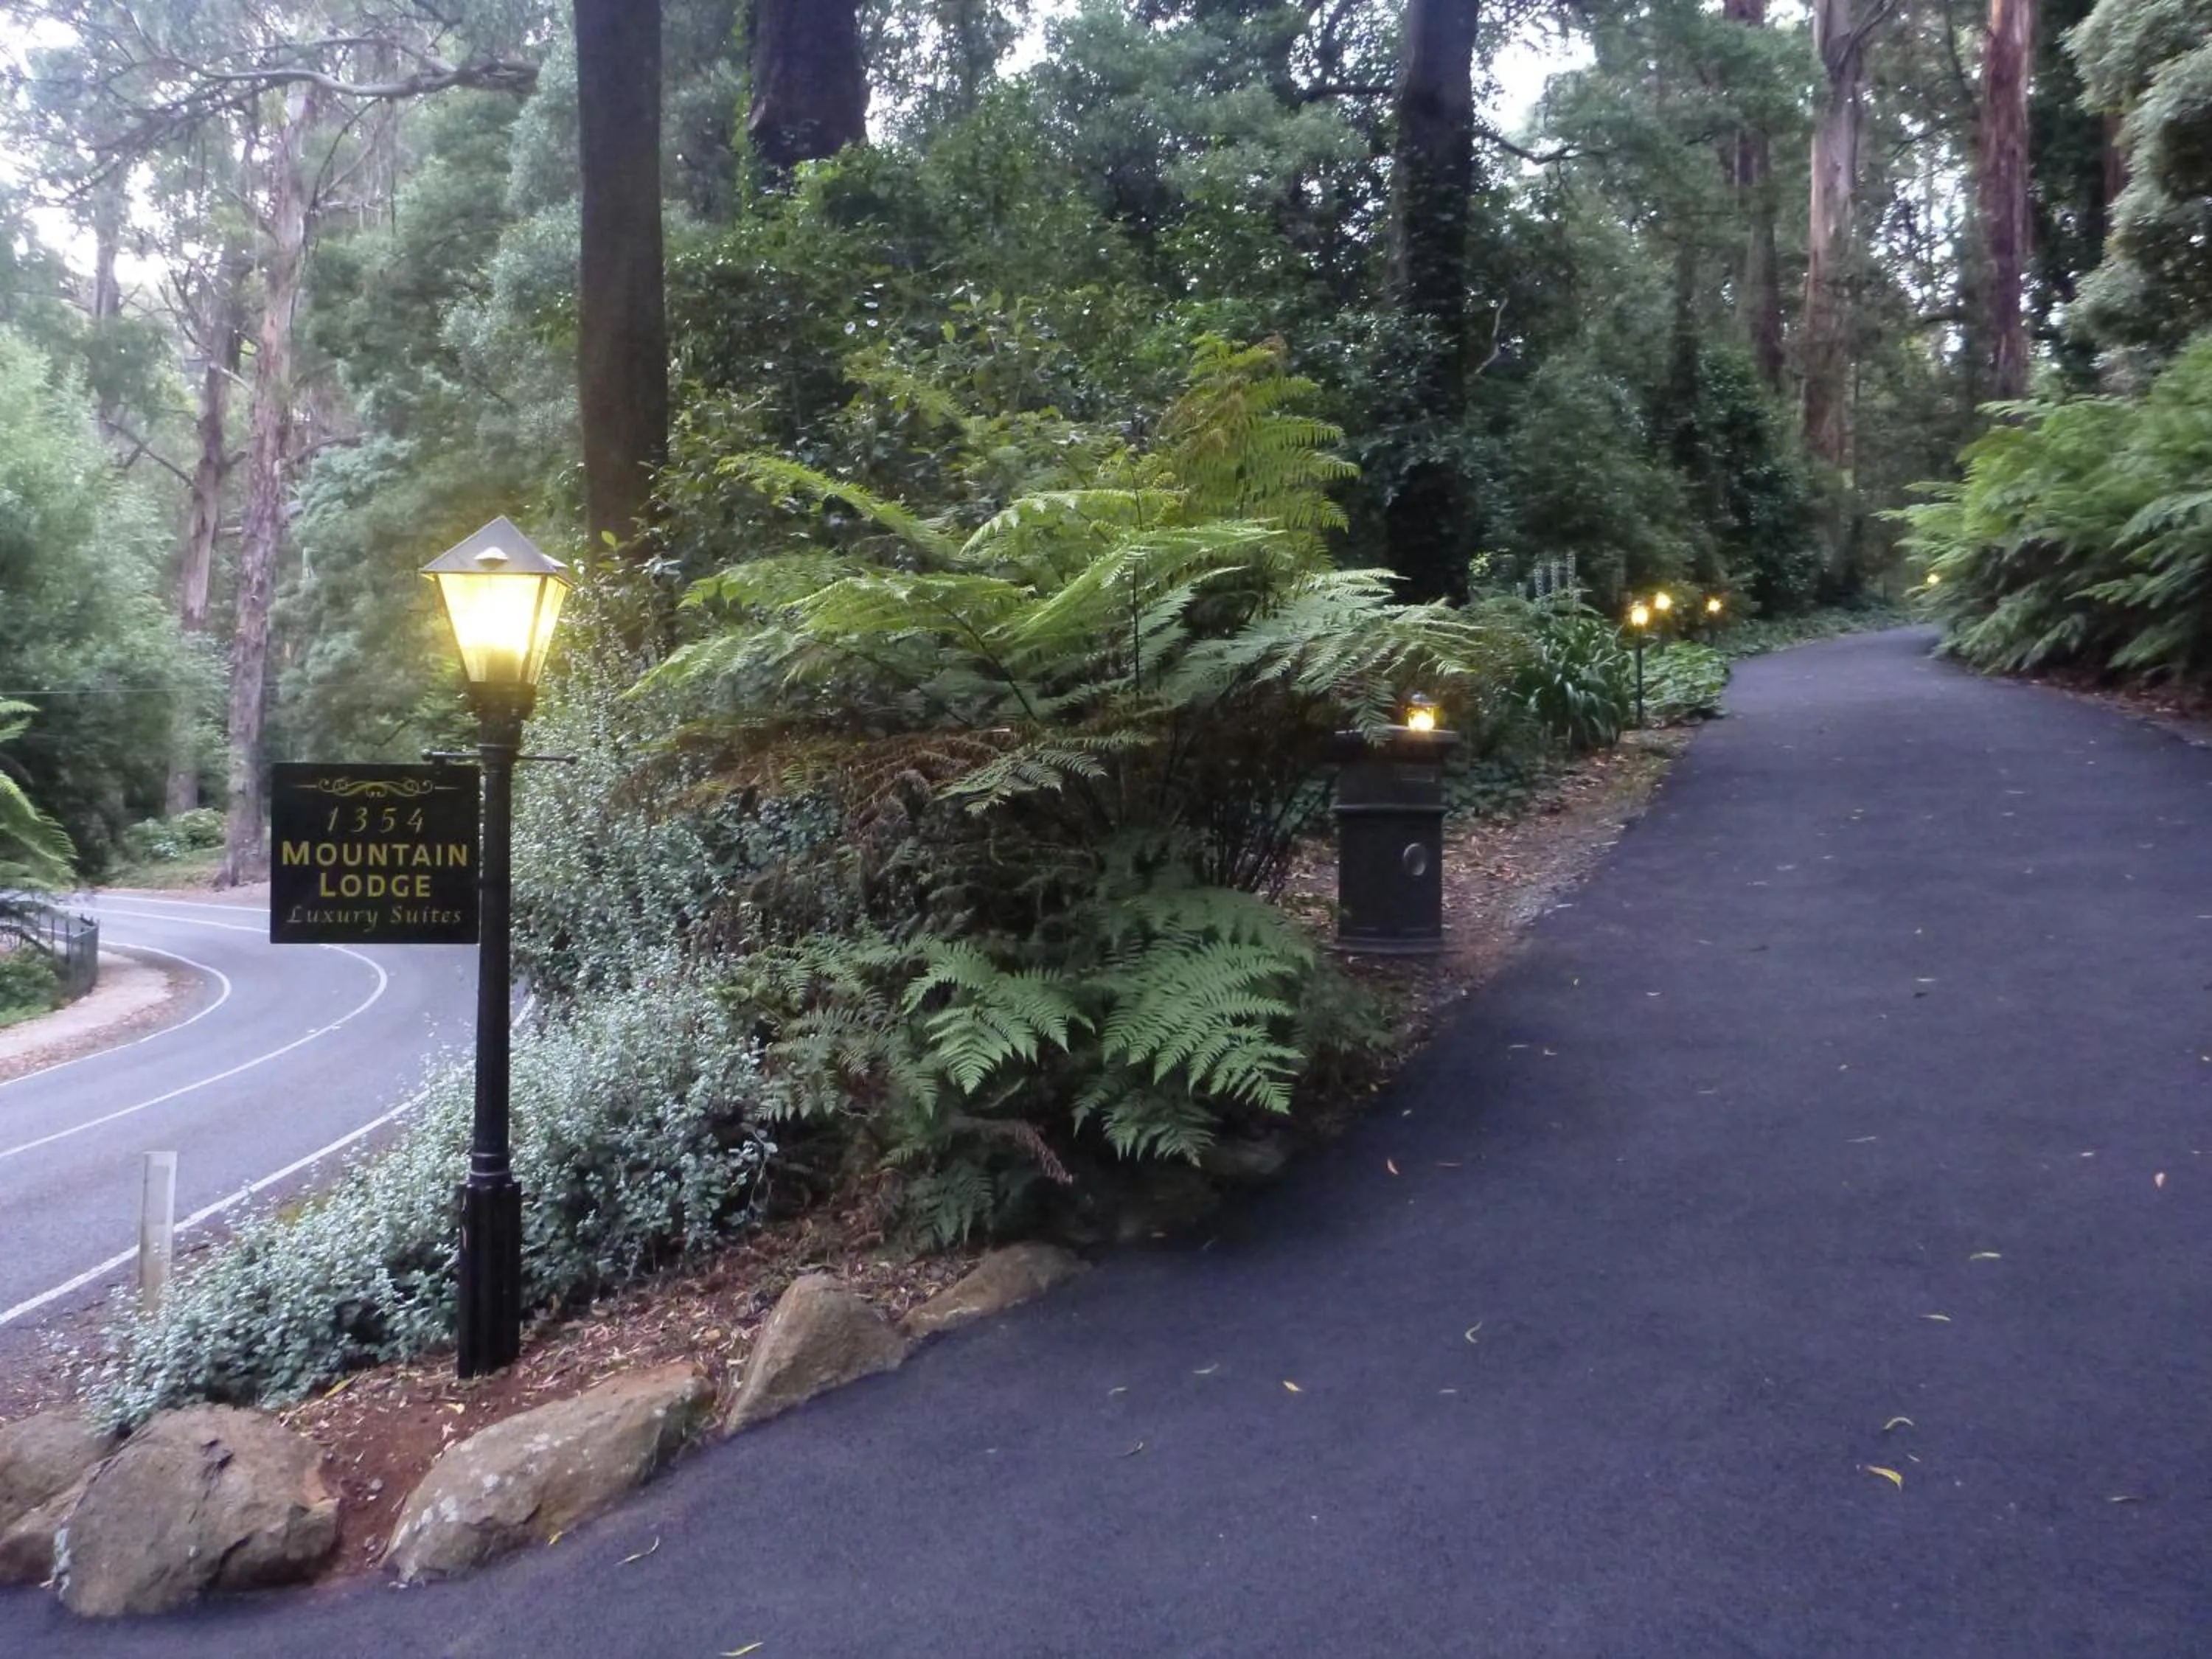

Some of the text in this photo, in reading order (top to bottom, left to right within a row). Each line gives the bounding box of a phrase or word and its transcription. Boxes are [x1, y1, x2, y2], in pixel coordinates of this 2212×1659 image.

[327, 807, 423, 833] 1354
[282, 841, 468, 866] MOUNTAIN
[319, 872, 432, 897] LODGE
[287, 905, 462, 933] Luxury Suites
